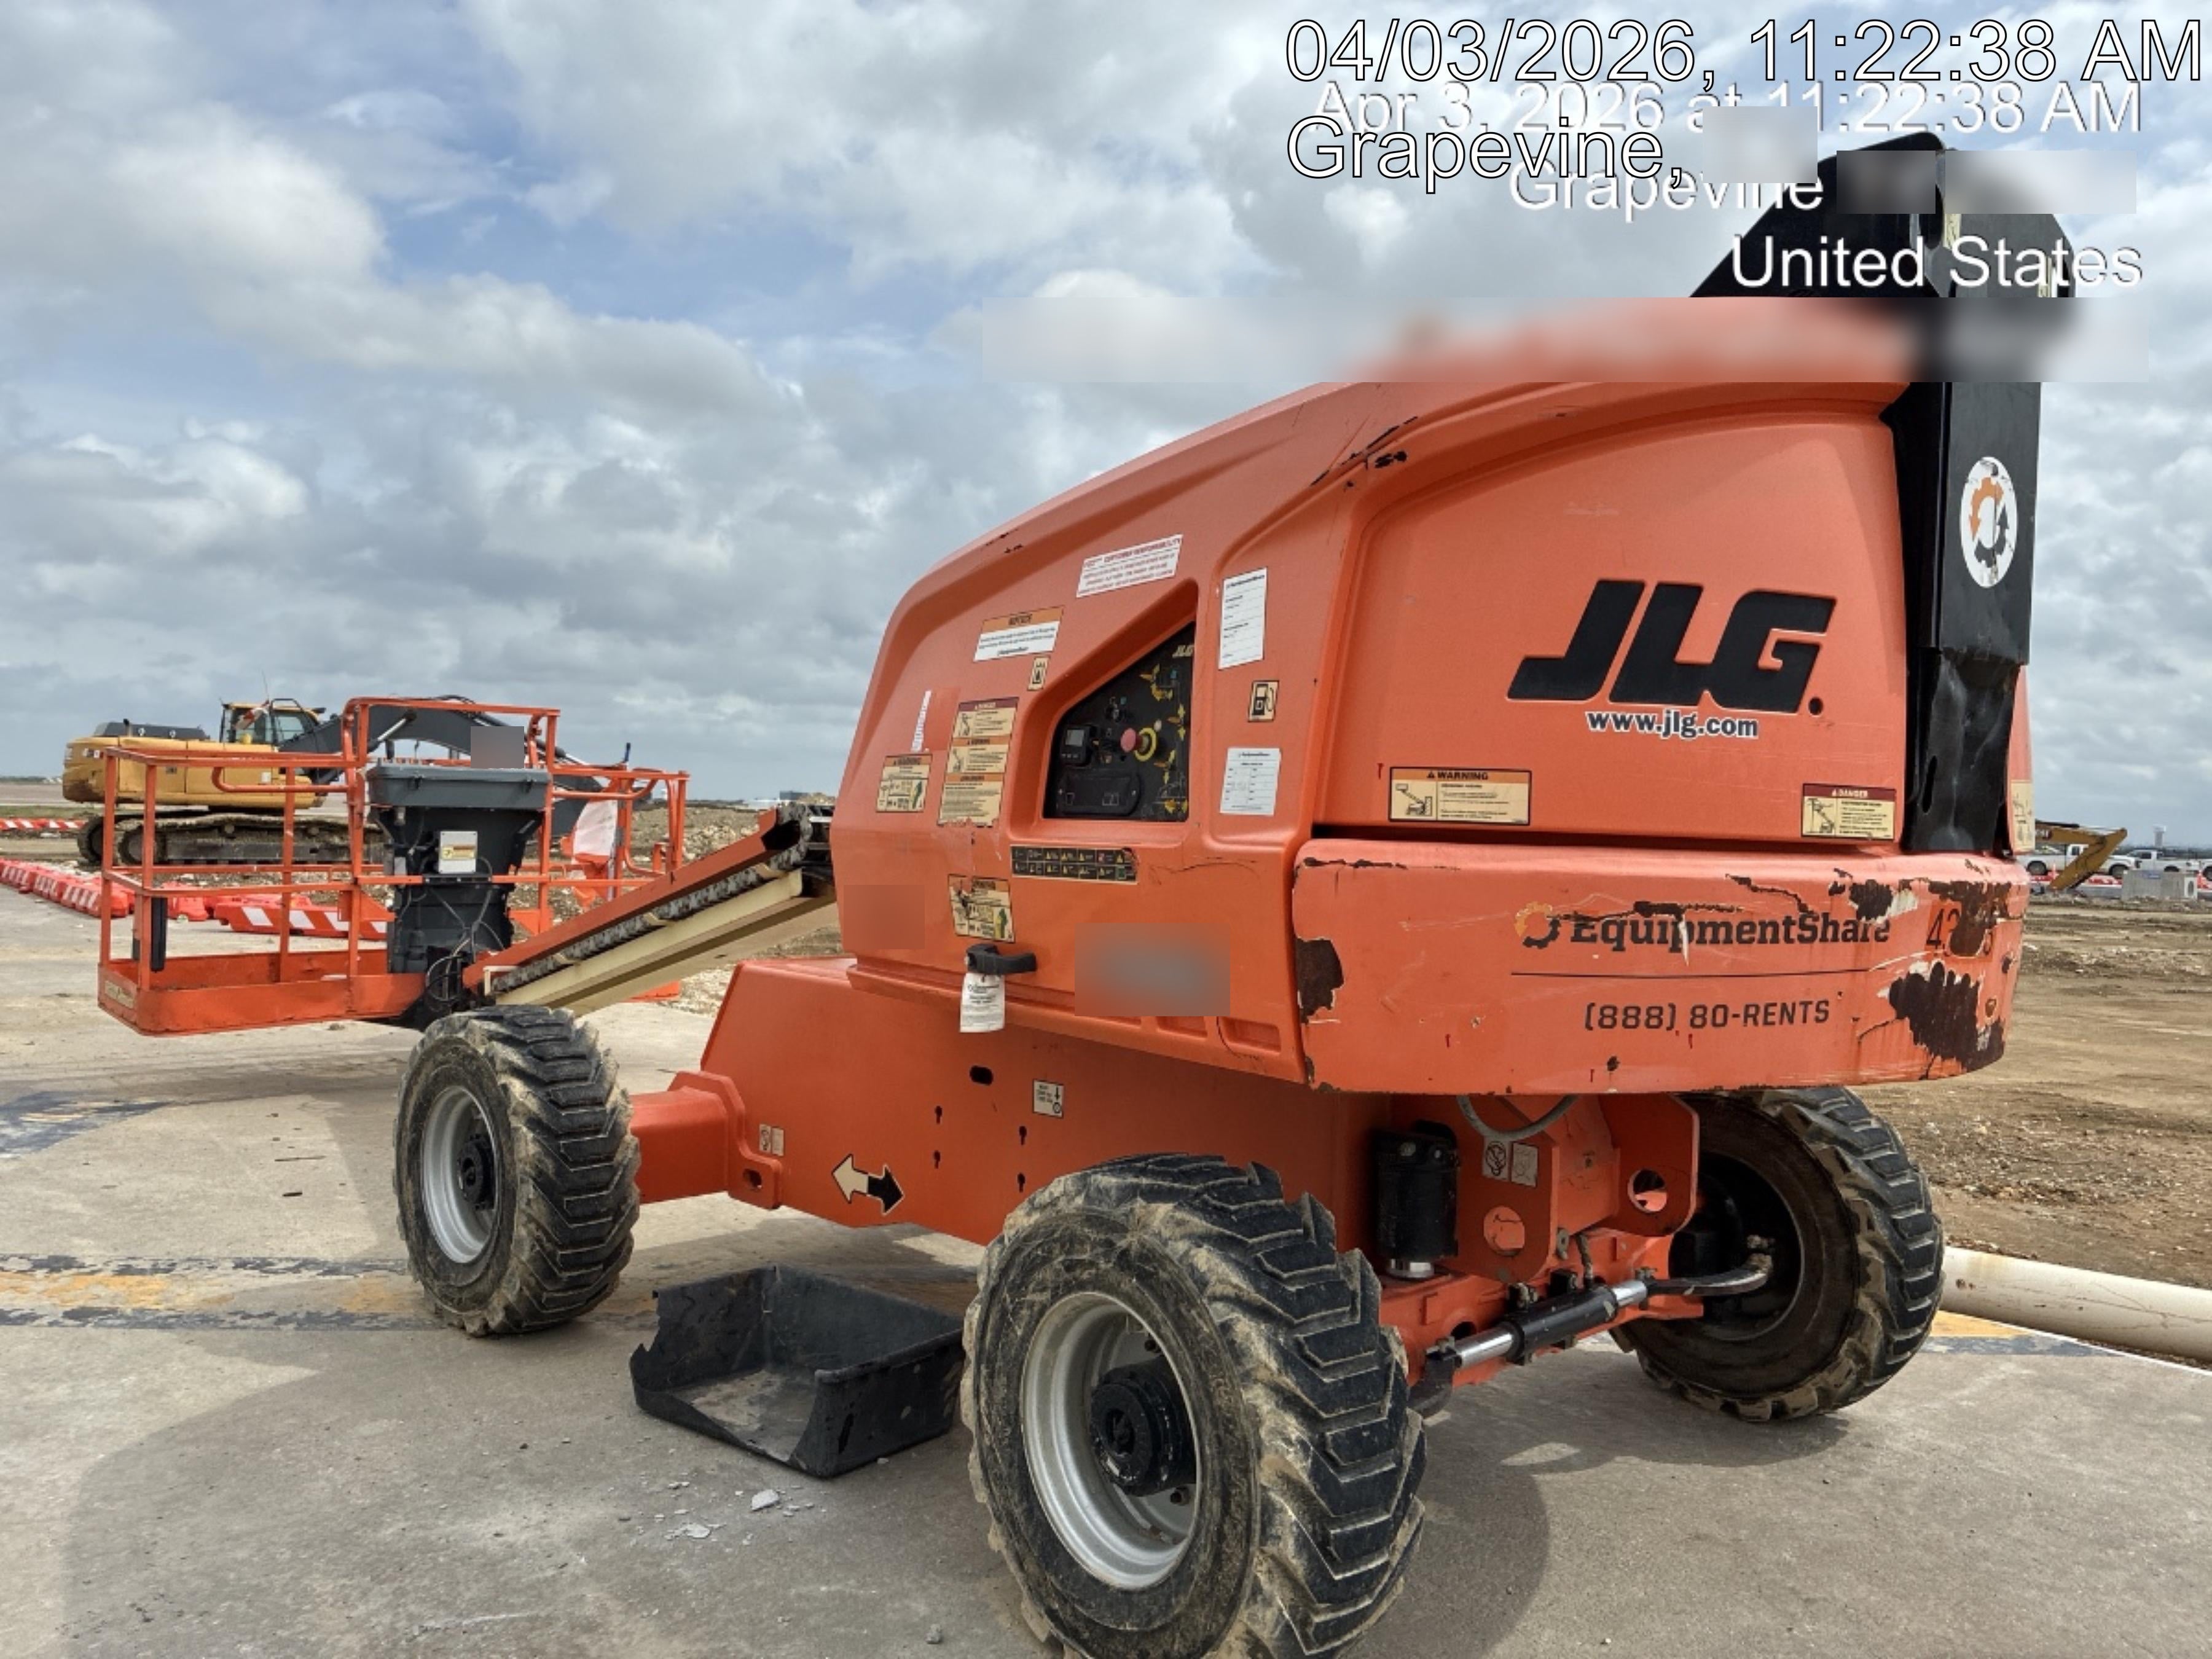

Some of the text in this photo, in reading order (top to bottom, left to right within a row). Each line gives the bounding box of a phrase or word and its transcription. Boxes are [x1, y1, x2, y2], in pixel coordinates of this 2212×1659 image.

[1506, 578, 1837, 715] JLG
[1585, 708, 1759, 740] www.jlg.com
[1437, 771, 1489, 780] WARNING
[1839, 789, 1869, 798] DANGER
[1571, 912, 1891, 952] EquipmentShare
[1584, 999, 1830, 1031] (888) 80-RENTS
